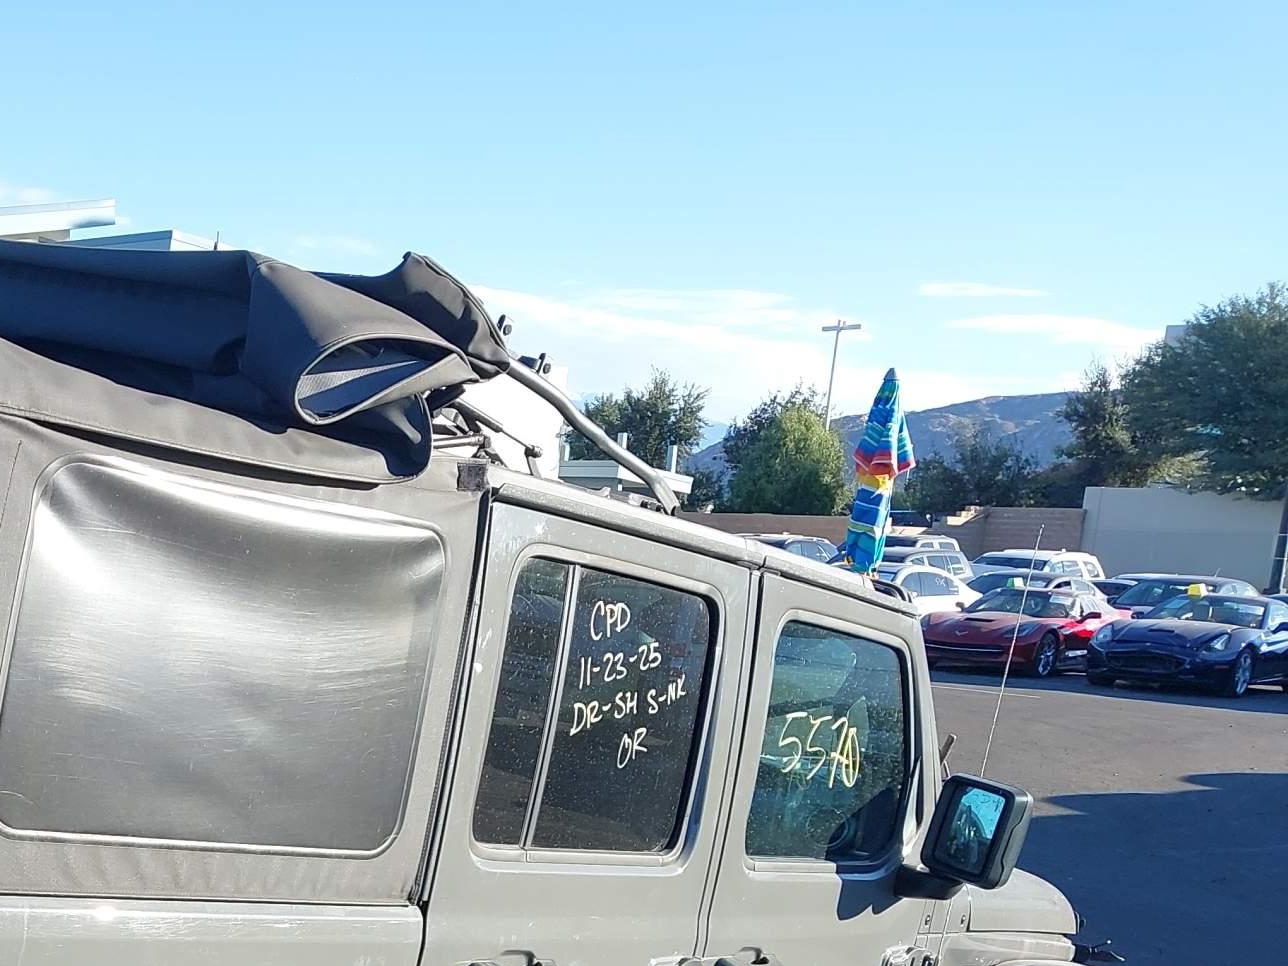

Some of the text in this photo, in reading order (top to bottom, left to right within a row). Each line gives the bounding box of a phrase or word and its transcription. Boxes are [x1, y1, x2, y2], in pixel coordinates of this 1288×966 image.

[590, 600, 631, 641] CPD
[579, 641, 662, 690] 11-23-25
[569, 674, 687, 737] DR-SH S-NK
[616, 727, 648, 769] OR
[778, 711, 860, 788] 5570
